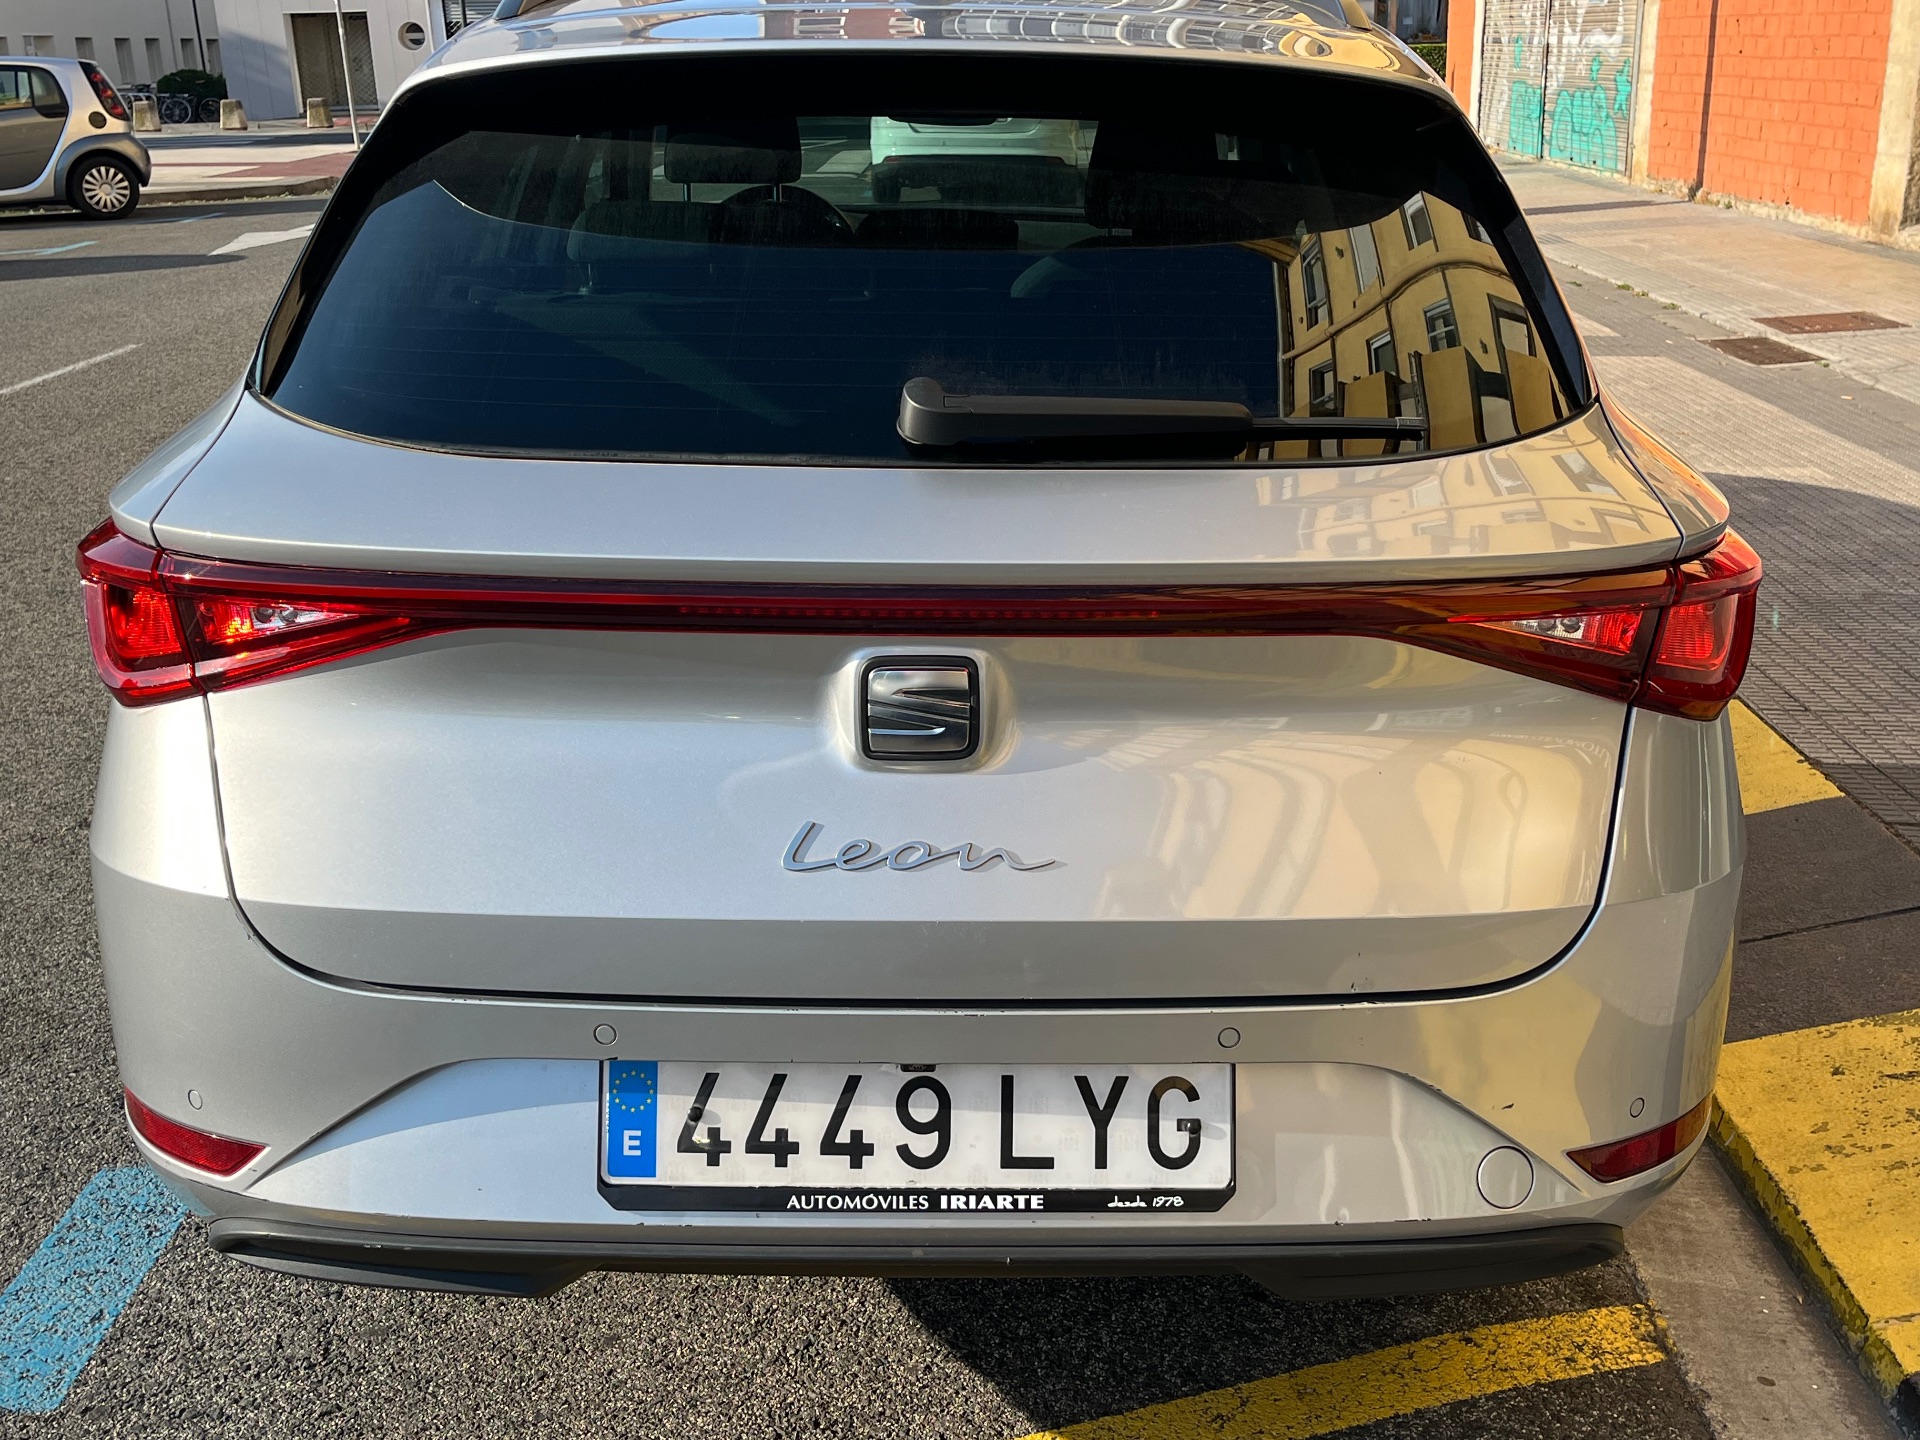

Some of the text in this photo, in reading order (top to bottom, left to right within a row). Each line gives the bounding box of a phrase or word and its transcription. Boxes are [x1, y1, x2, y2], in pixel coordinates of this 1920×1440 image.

[780, 820, 1056, 872] Leon
[623, 1072, 1202, 1171] E 4449 LYG
[786, 1193, 1185, 1211] AUTOMÓVILES IRIARTE desde 1978
